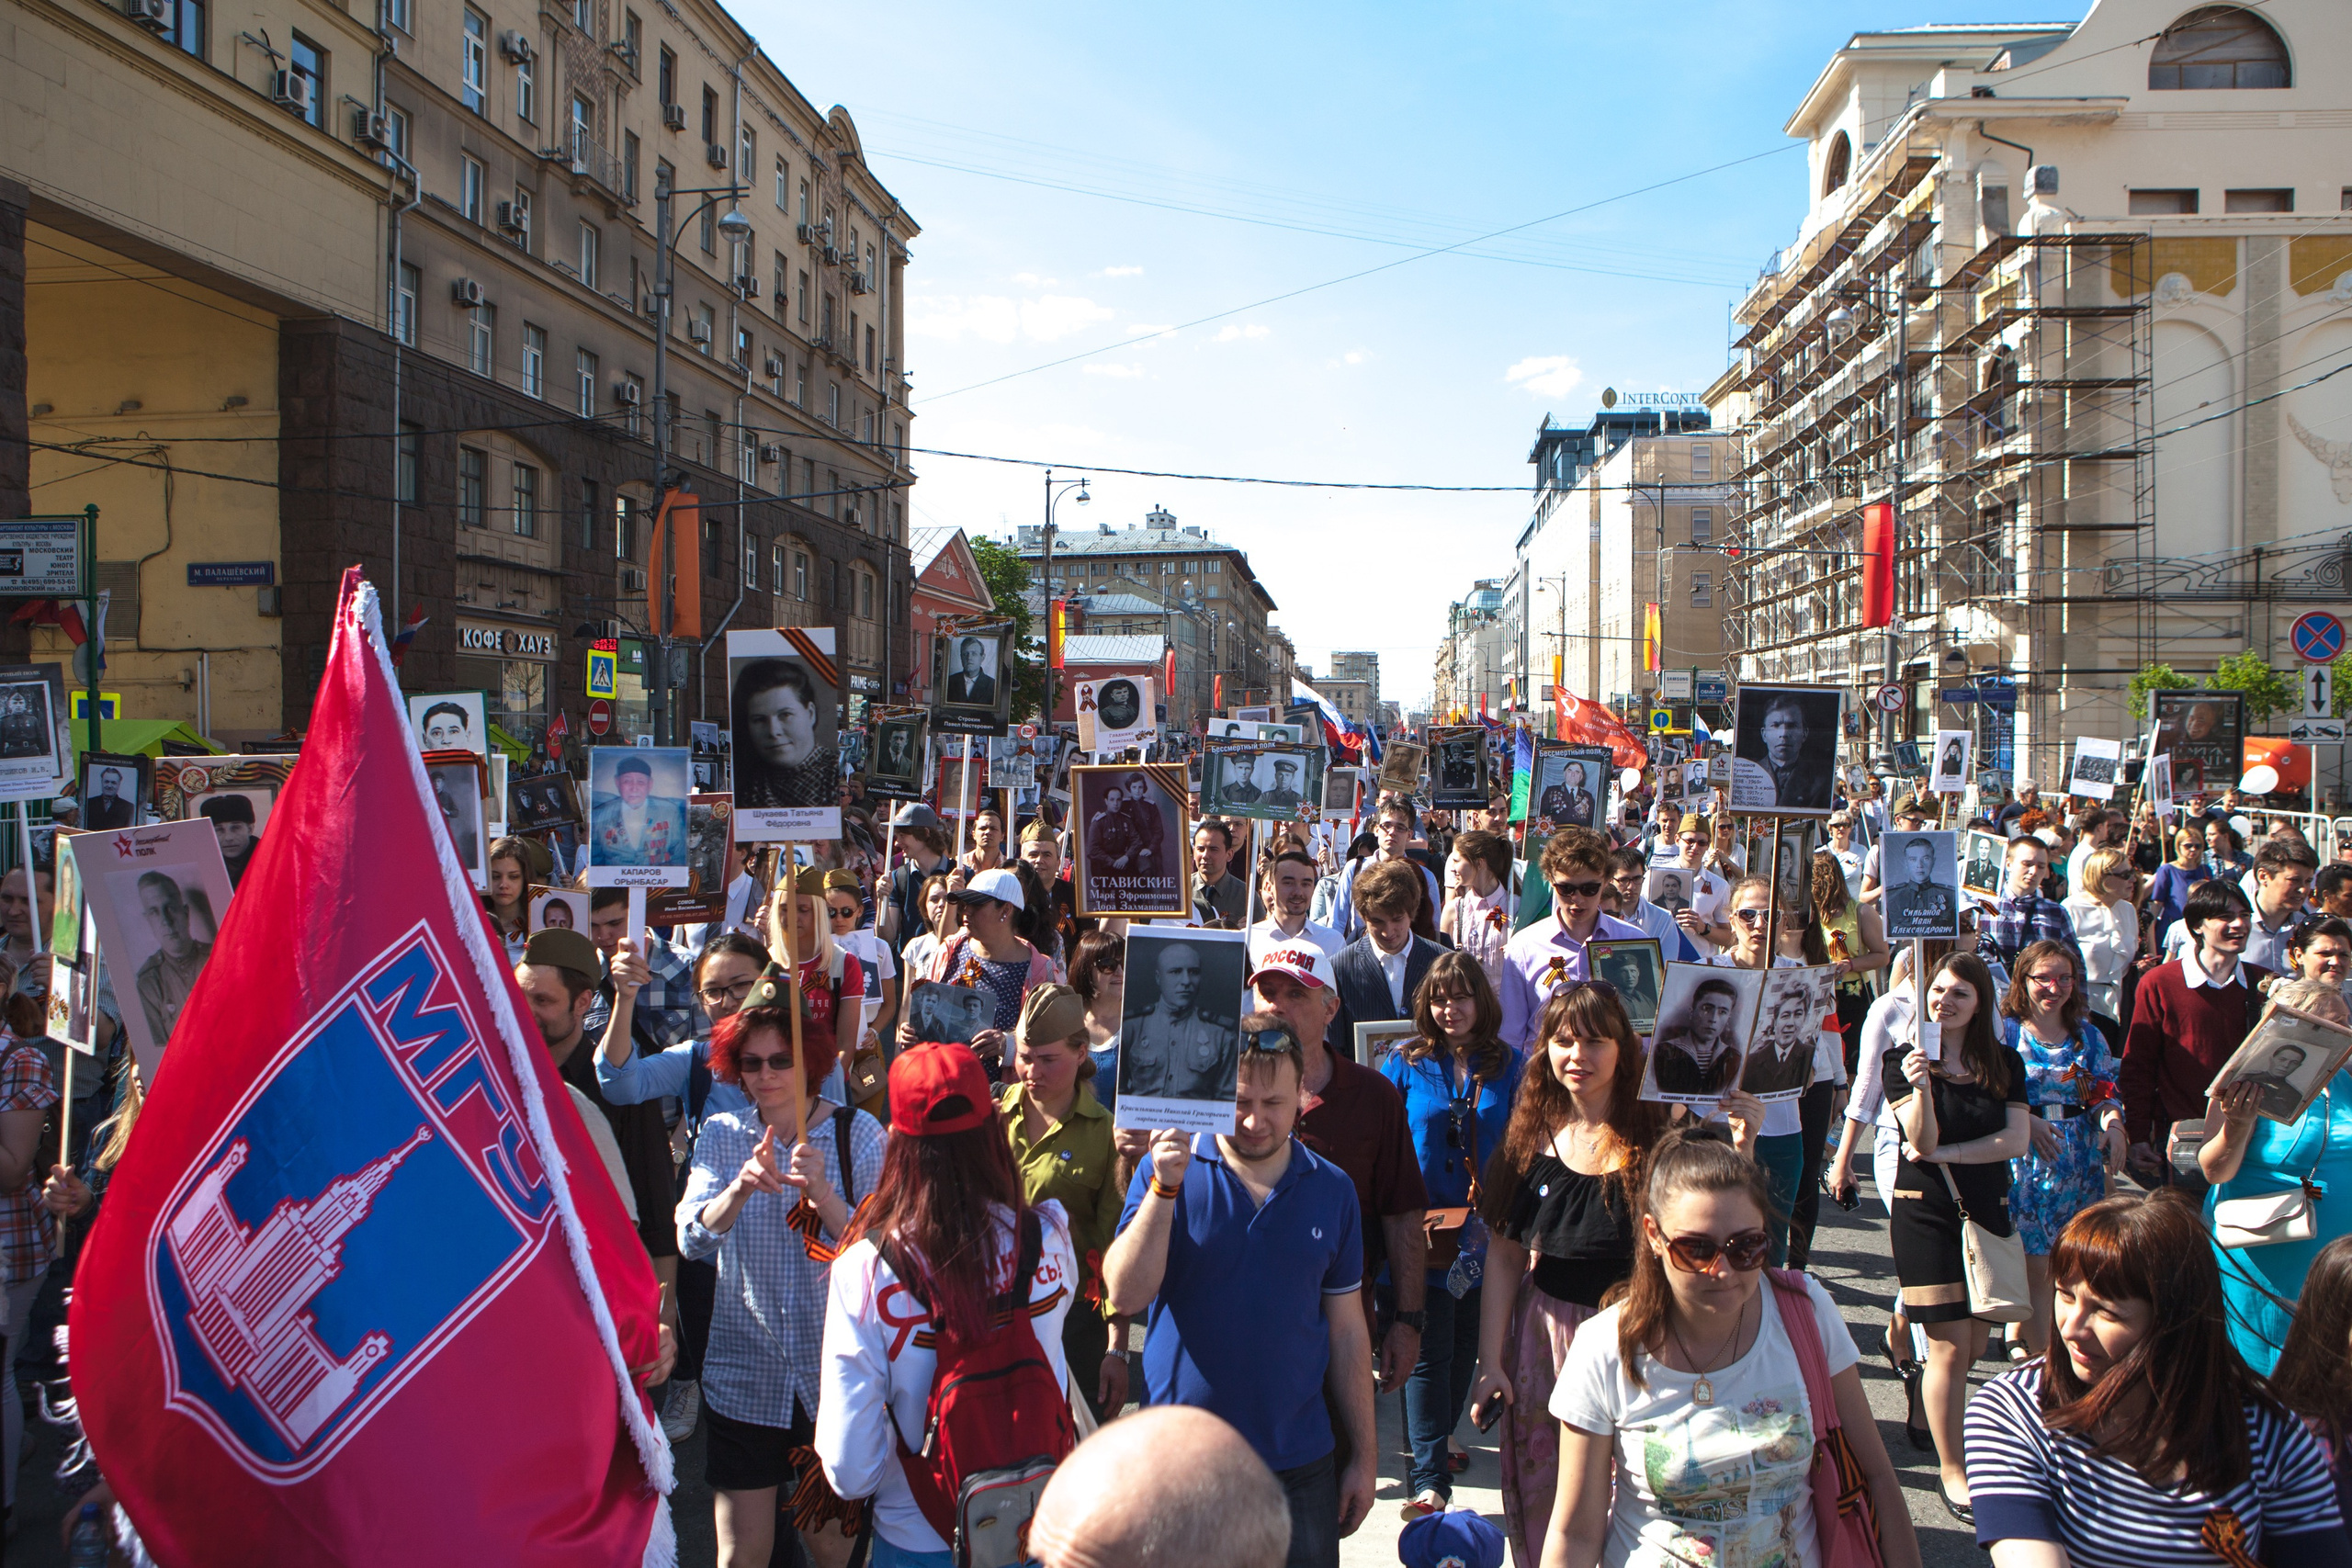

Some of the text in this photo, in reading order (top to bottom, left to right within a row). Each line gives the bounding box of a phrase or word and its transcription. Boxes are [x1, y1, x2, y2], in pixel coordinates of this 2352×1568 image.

[194, 566, 266, 577] М. ПАЛАШЁВСКИЙ
[1890, 618, 1905, 634] 16
[462, 627, 551, 654] КОФЕ ХАУЗ
[851, 675, 866, 689] PRIME
[1211, 743, 1259, 754] Бессмертный
[1539, 748, 1585, 758] Бессмертный
[866, 786, 894, 795] Александр
[752, 809, 789, 819] Шукаева
[765, 819, 811, 829] Фёдоровна
[1090, 876, 1177, 888] СТАВИСКИЕ
[1090, 889, 1178, 902] Марк Эфроимович
[1092, 901, 1175, 912] Дора Залмановна
[1261, 949, 1316, 973] РОССИЯ
[365, 942, 554, 1224] МГУ
[1120, 1104, 1230, 1119] Красильников Николай Григорьевич
